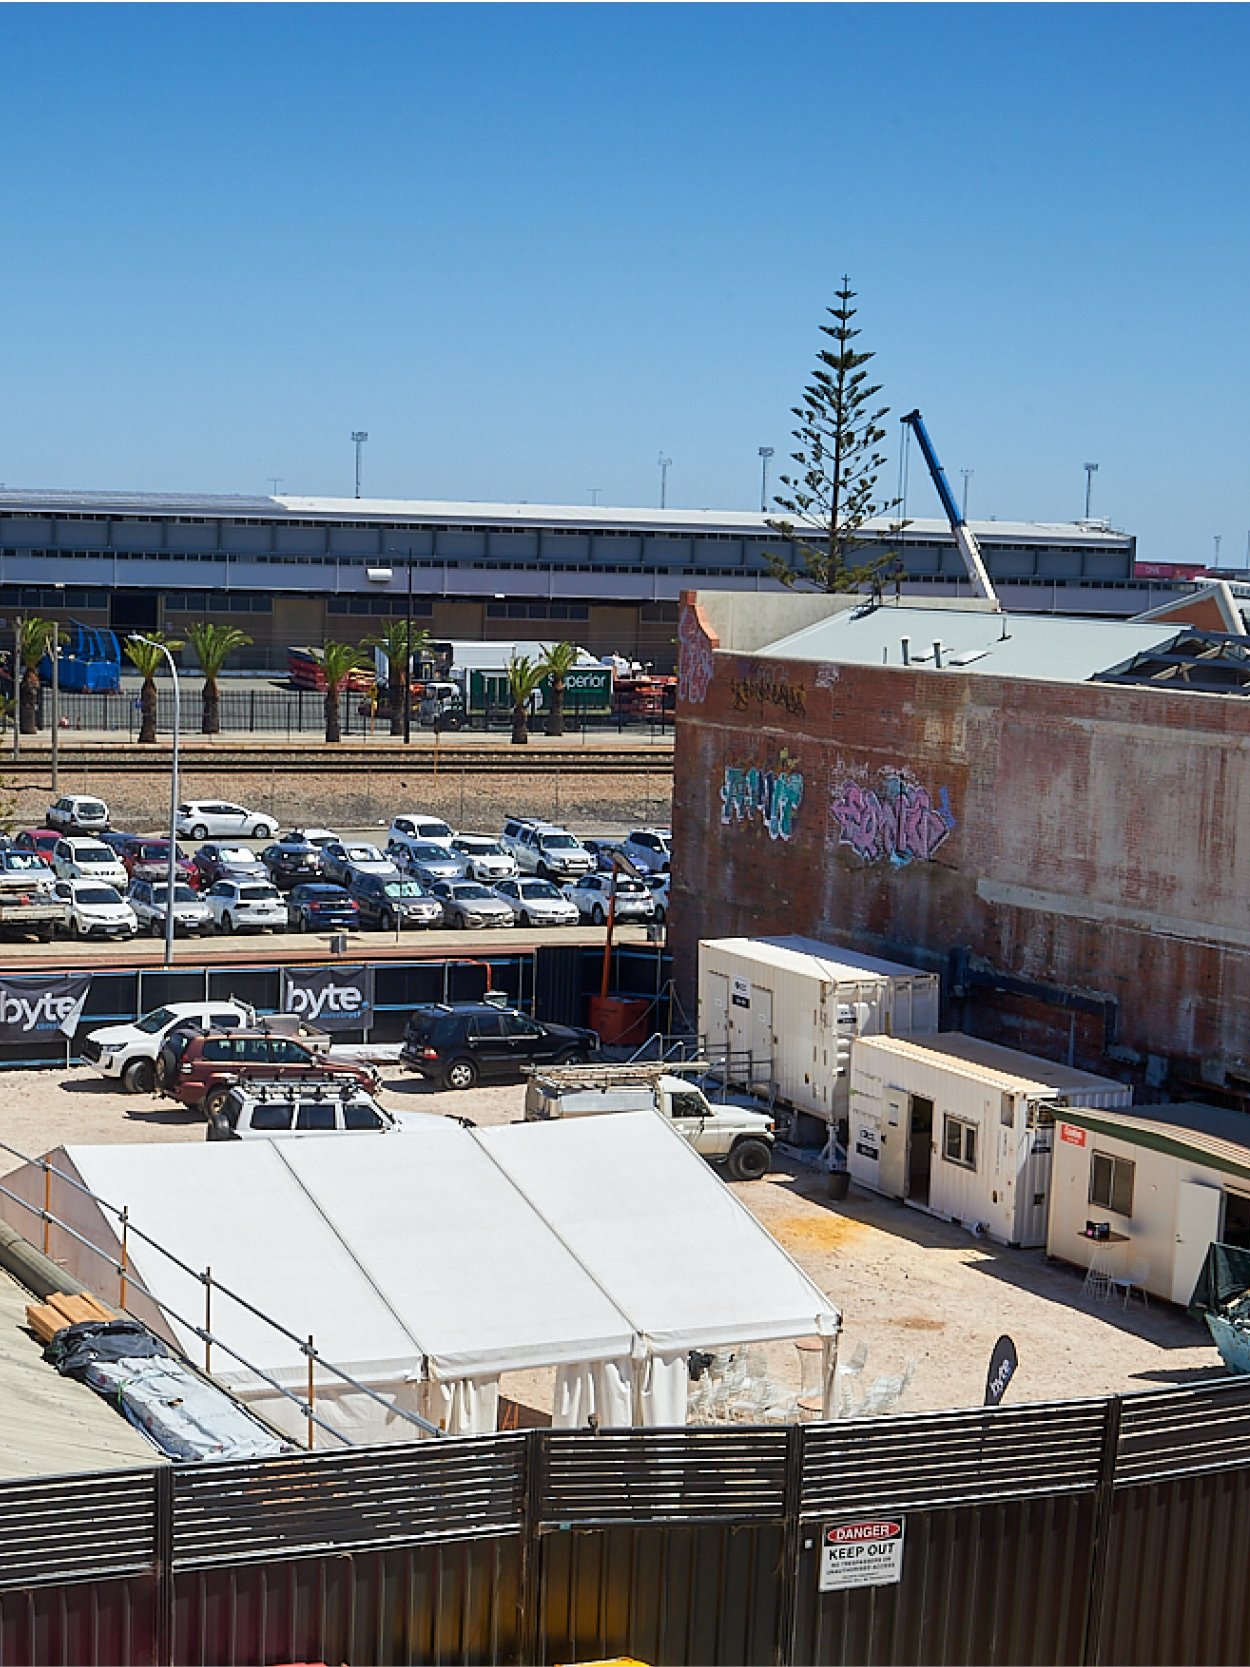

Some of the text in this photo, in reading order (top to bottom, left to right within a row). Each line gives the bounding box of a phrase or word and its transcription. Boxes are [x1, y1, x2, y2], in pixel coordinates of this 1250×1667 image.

[547, 673, 607, 691] Sperior
[286, 981, 362, 1020] byte
[0, 990, 78, 1032] byte
[836, 1525, 889, 1540] DANGER
[829, 1543, 895, 1560] KEEP OUT
